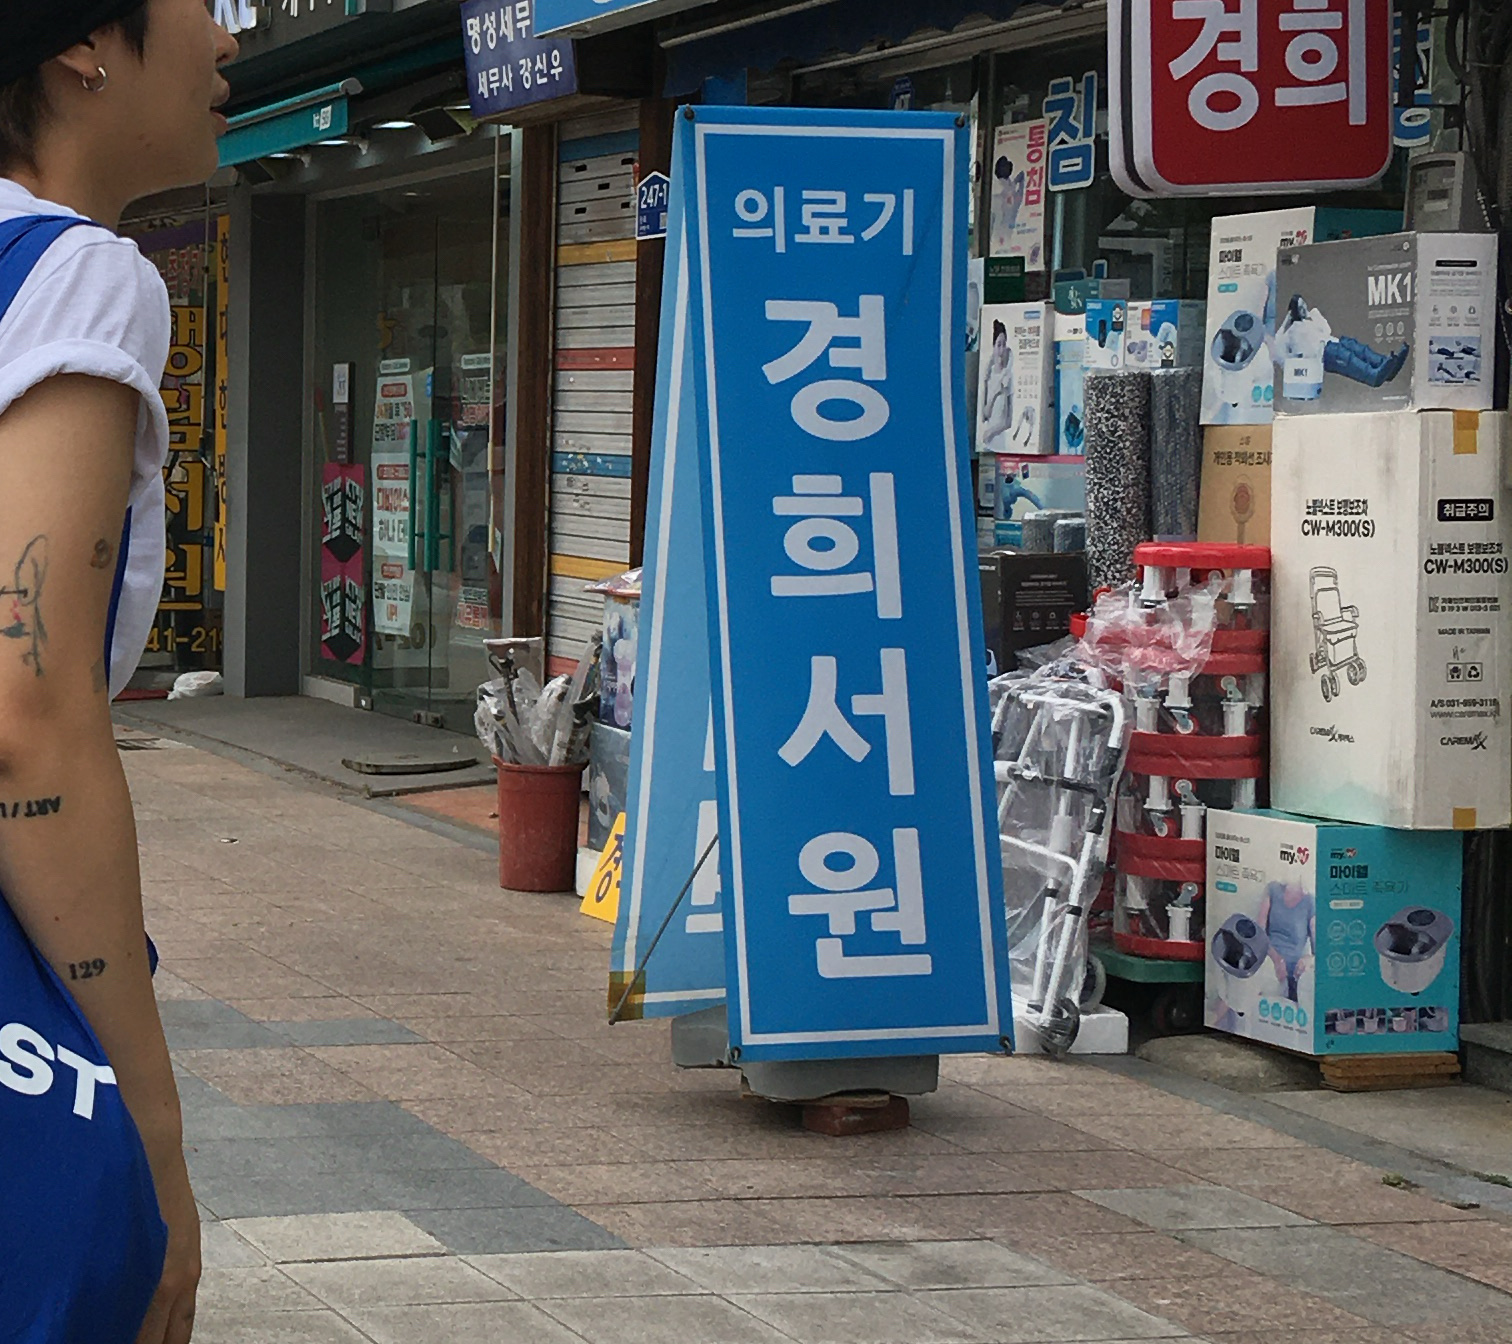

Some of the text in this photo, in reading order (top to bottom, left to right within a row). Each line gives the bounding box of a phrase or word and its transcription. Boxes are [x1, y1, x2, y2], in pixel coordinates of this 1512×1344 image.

[466, 0, 531, 54] 명성세무
[477, 49, 563, 98] 세무사 강신우
[1043, 70, 1097, 192] 침
[732, 187, 917, 258] 의료기
[1367, 272, 1412, 306] MK1
[1302, 519, 1376, 538] CW-M300(S)
[1443, 503, 1489, 517] 취급주의
[1424, 558, 1509, 575] CW-M300(S)
[762, 294, 934, 981] 경희서원
[69, 958, 106, 981] 129
